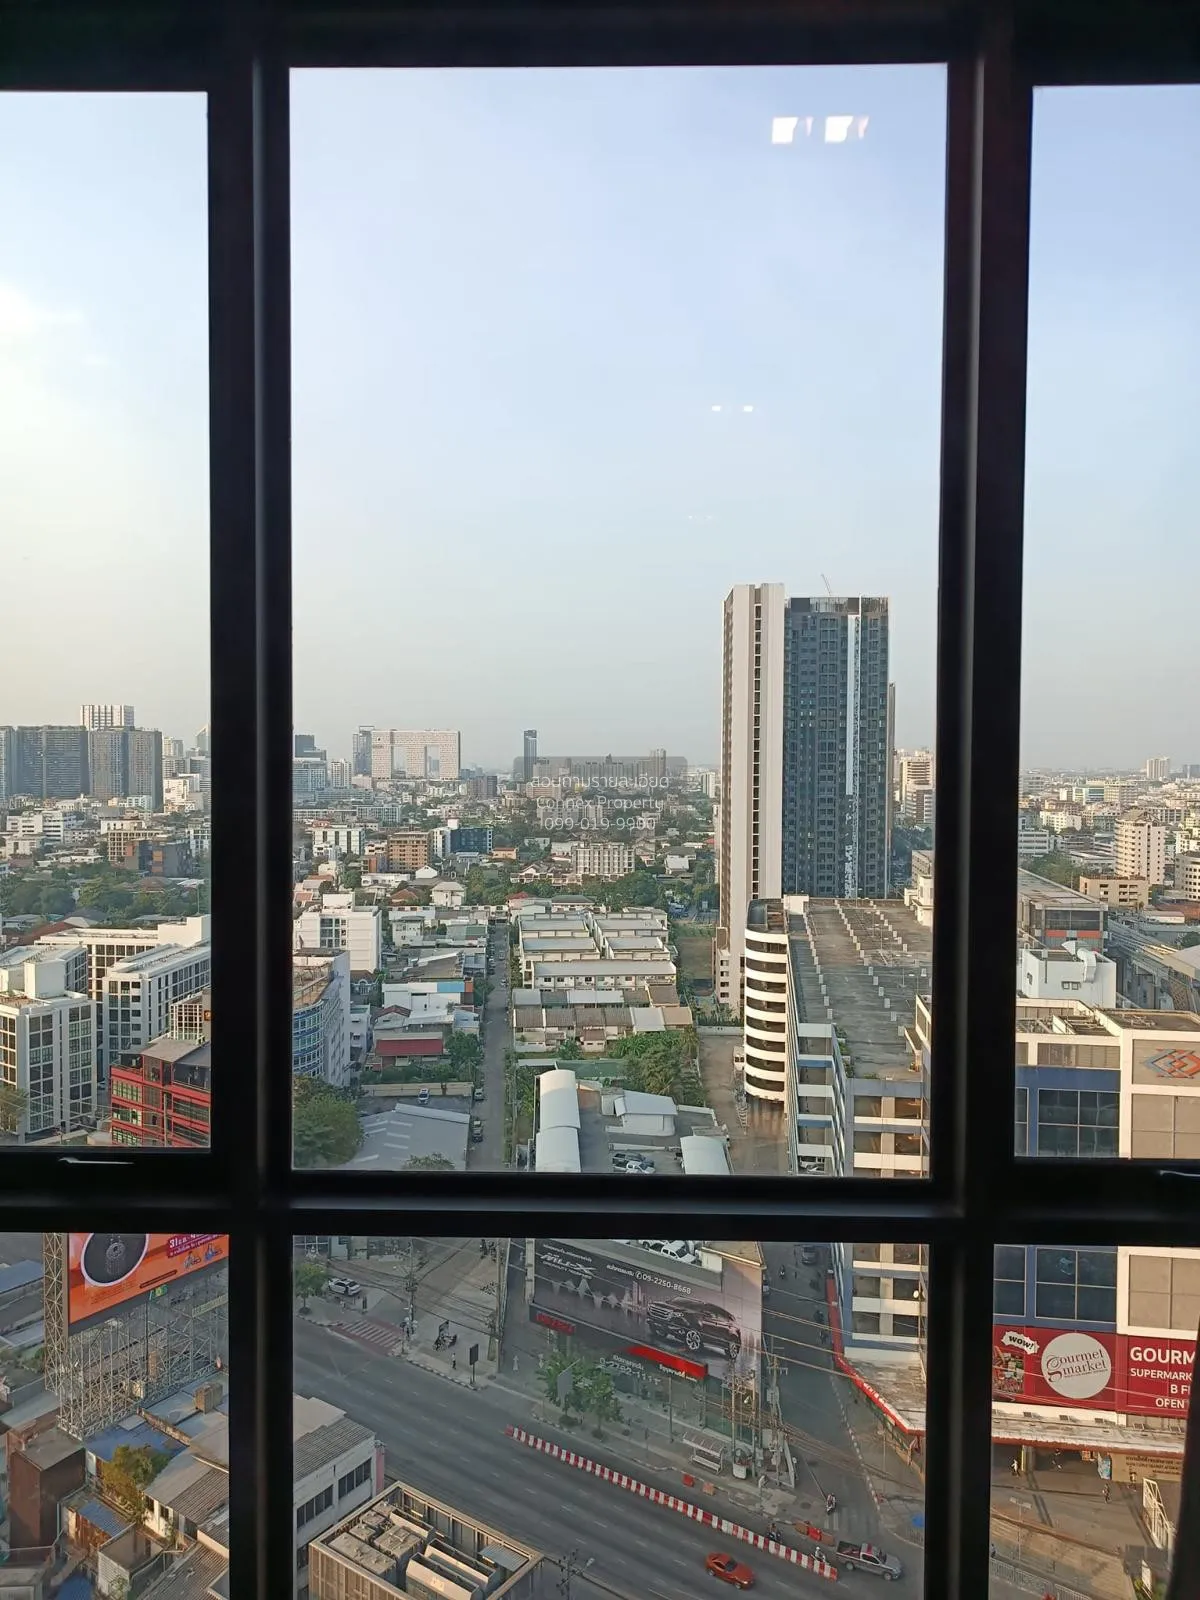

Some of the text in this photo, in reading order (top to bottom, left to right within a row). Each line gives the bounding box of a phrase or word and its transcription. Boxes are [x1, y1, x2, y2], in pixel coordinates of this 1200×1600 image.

[1046, 1349, 1104, 1378] Gourmet
[1063, 1360, 1106, 1375] market
[1170, 1384, 1178, 1394] B
[1155, 1398, 1185, 1409] OPEN
